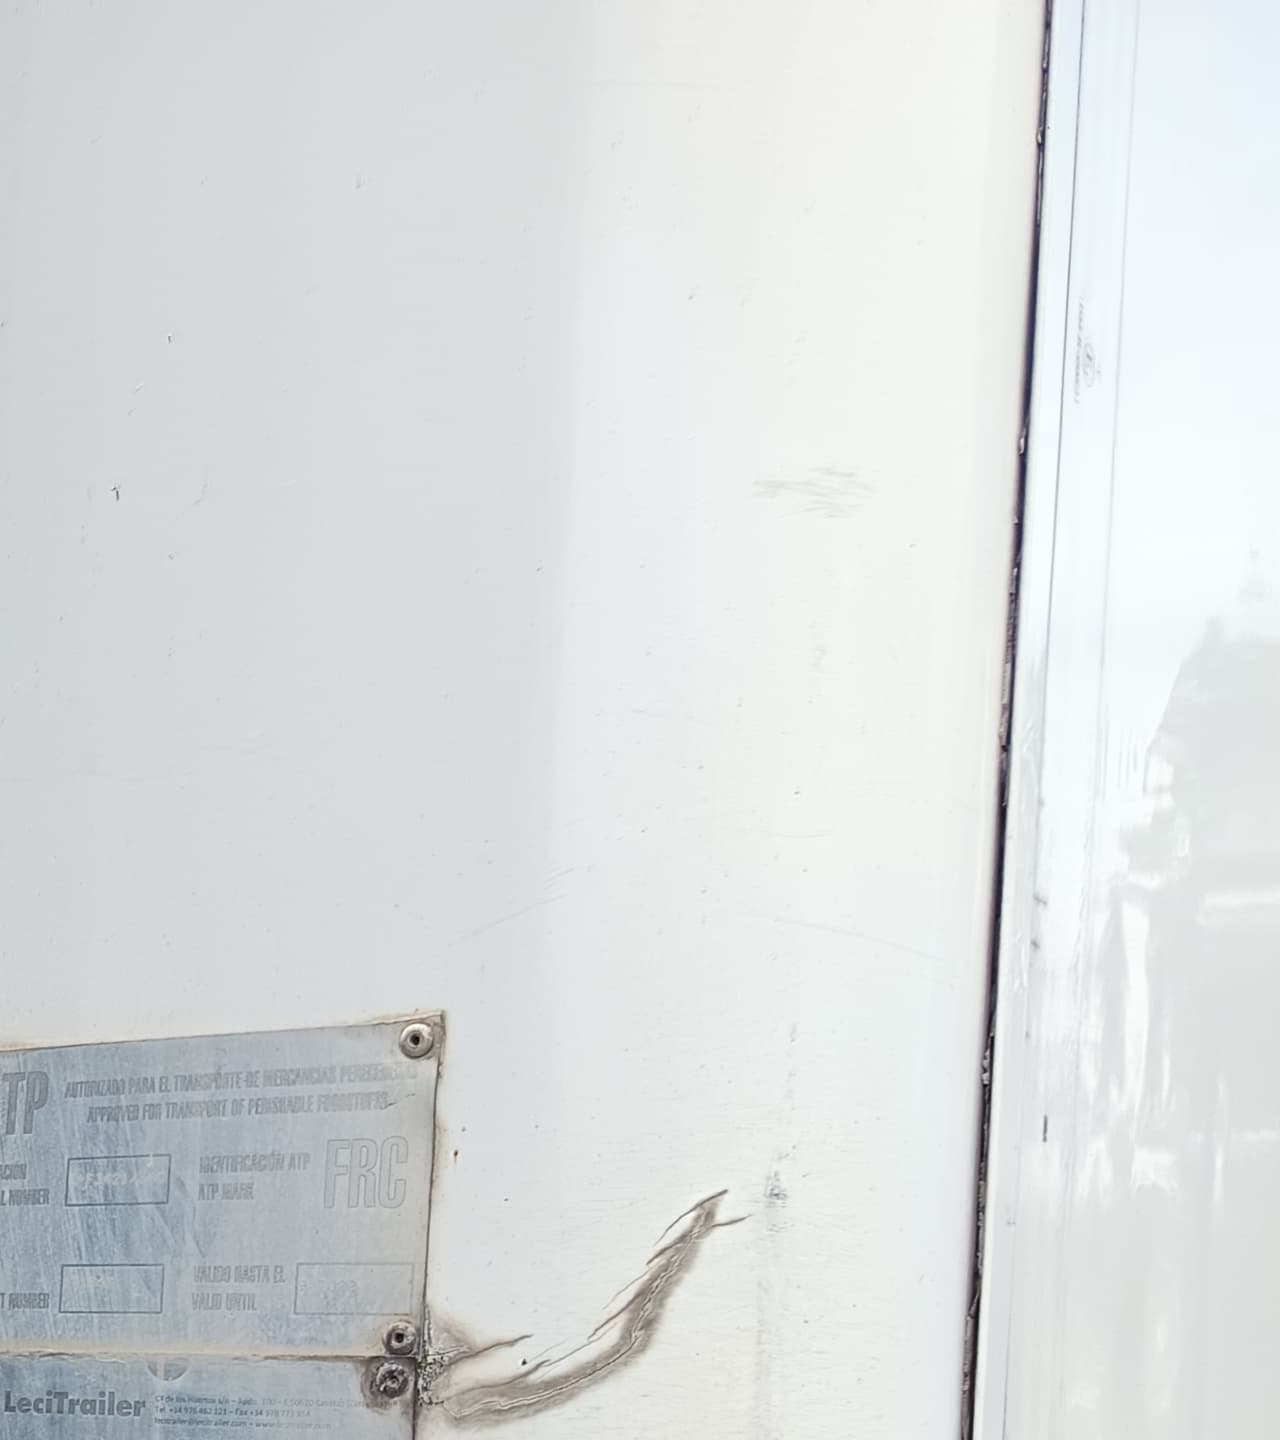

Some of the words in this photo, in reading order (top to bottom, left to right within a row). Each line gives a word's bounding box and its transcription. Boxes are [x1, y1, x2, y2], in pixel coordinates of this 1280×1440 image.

[64, 1079, 126, 1098] AUTORIZADO
[128, 1077, 156, 1095] PARA
[159, 1075, 172, 1093] EL
[88, 1102, 139, 1123] APPROVED
[142, 1102, 162, 1120] FOR
[287, 1152, 311, 1171] ATP
[324, 1134, 409, 1209] FRC
[198, 1182, 219, 1201] ATP
[4, 1390, 147, 1418] LeciTrailer
